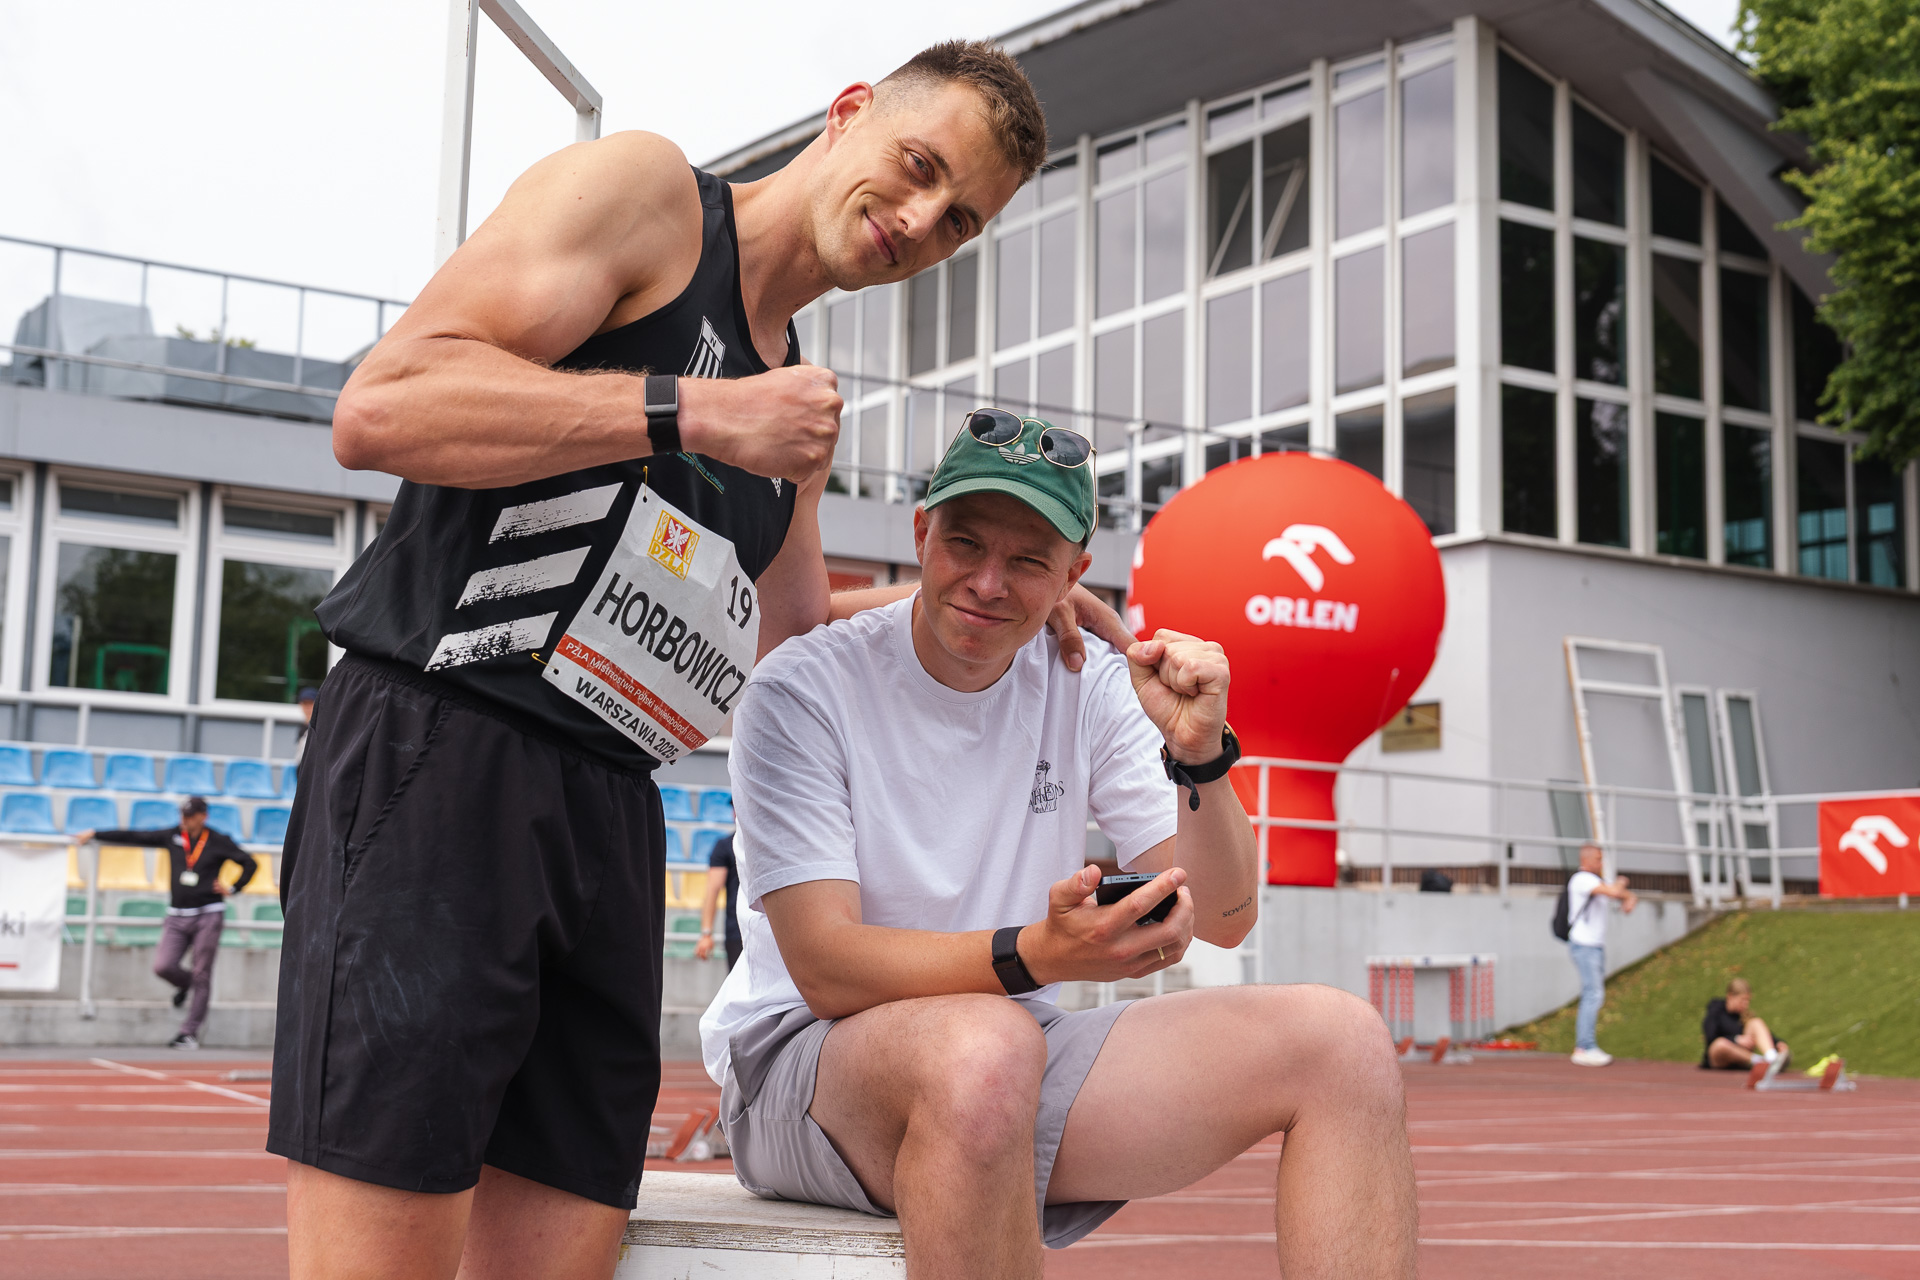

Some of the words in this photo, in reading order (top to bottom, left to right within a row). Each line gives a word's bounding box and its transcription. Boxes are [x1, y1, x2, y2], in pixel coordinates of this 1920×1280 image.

[650, 542, 685, 577] PZLA
[727, 575, 753, 629] 19
[1245, 594, 1359, 633] ORLEN
[565, 642, 589, 663] PZLA
[590, 656, 634, 694] Mistrzostwa
[592, 572, 746, 715] HORBOWICZ
[575, 676, 658, 746] WARSZAWA
[653, 737, 680, 759] 2025
[1222, 896, 1252, 918] CHAOS
